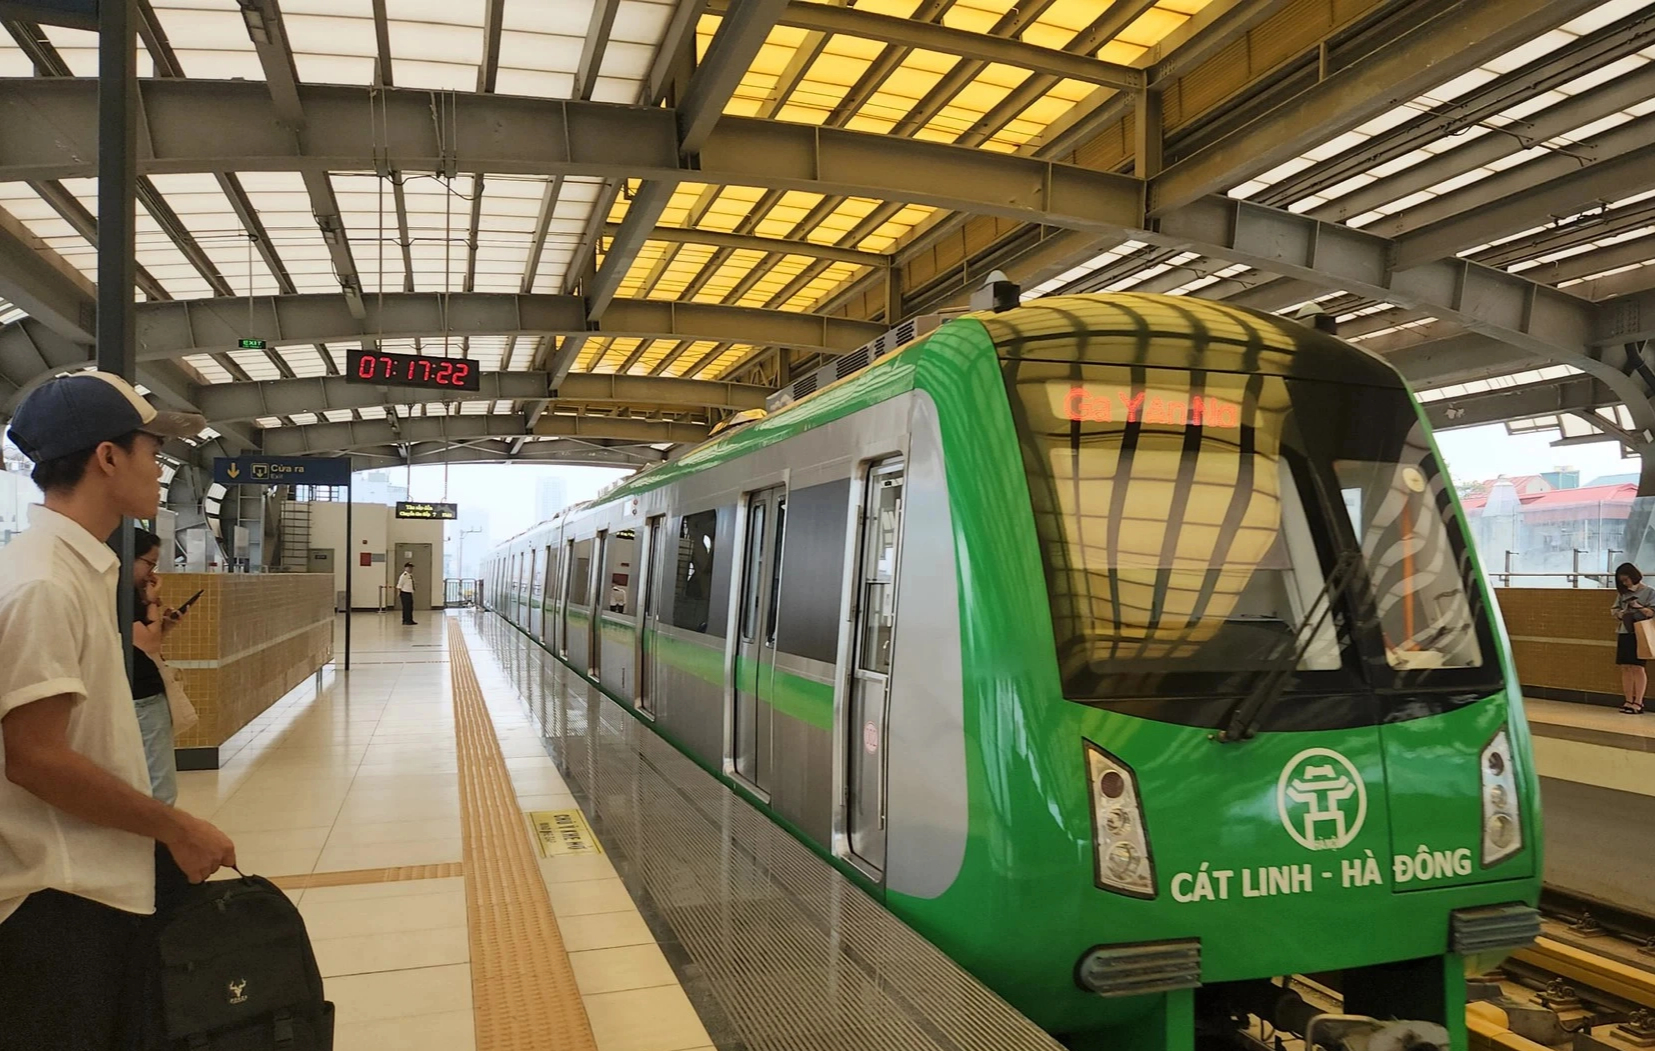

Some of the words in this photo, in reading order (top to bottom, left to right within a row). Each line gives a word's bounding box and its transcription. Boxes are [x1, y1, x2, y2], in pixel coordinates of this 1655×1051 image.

[359, 355, 469, 386] 07:17:22
[1063, 387, 1113, 423] Ga
[270, 463, 292, 472] Cửa
[1170, 861, 1234, 903] CÁT
[1242, 863, 1313, 897] LINH
[1341, 849, 1383, 888] HÀ
[1392, 844, 1473, 884] ĐÔNG
